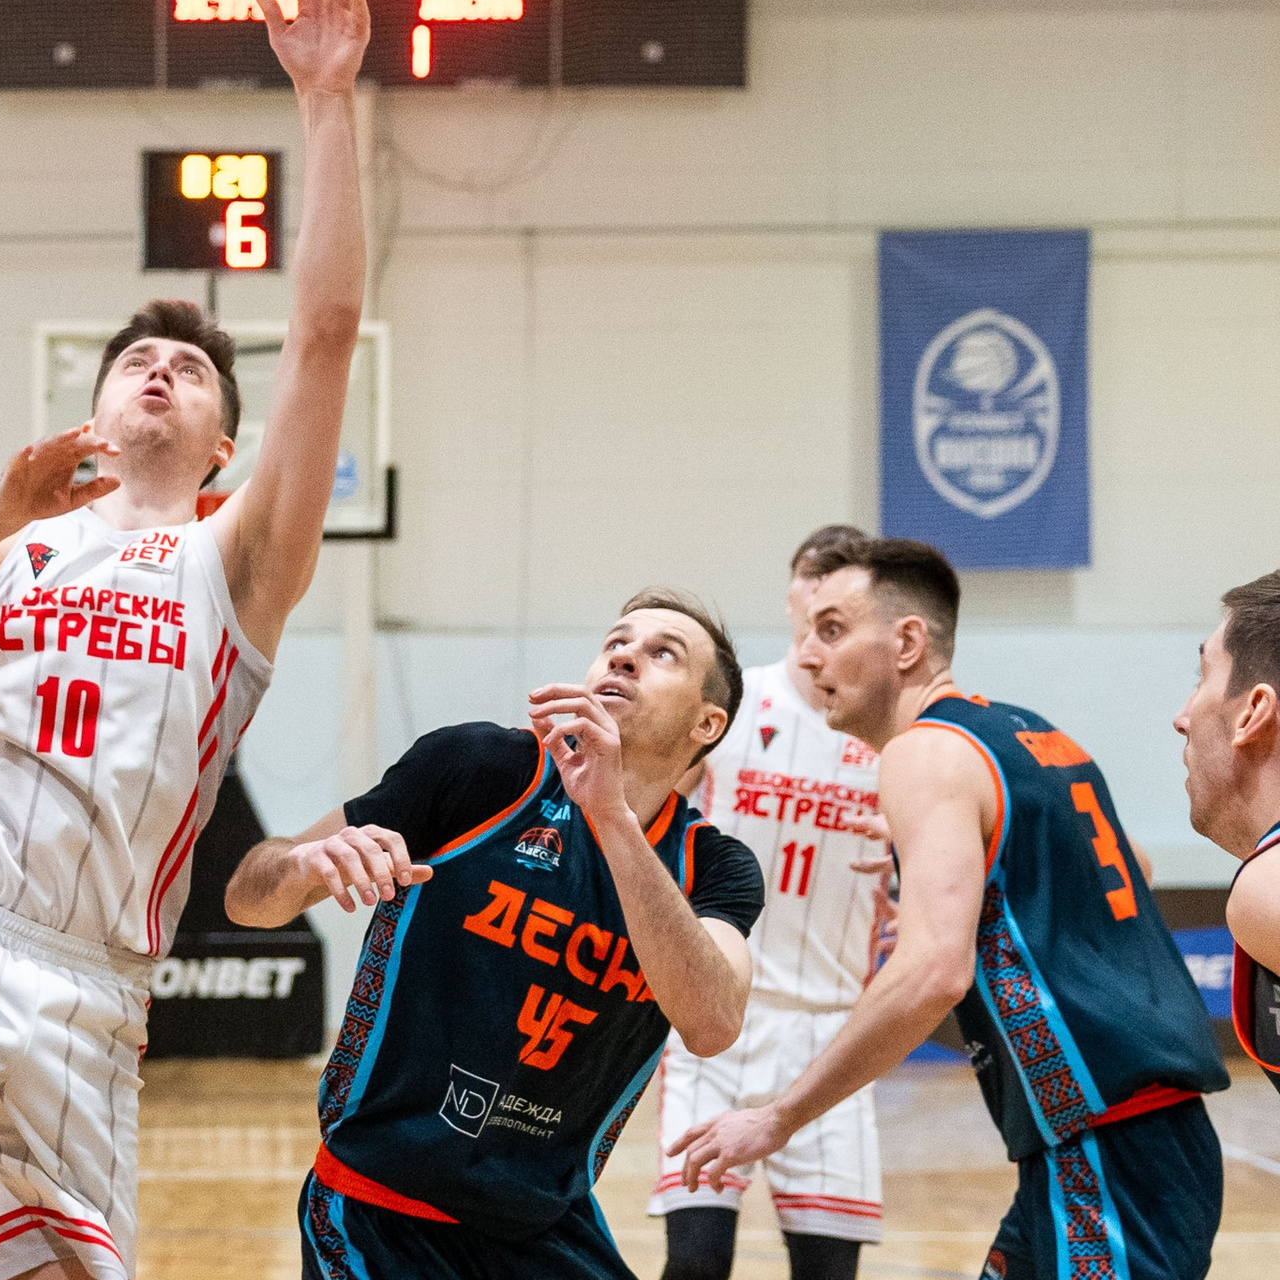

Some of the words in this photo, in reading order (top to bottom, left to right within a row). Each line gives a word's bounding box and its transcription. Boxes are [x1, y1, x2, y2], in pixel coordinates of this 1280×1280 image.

[225, 201, 267, 268] 6
[120, 546, 174, 564] BET
[3, 585, 185, 627] ОКСАРСКИЕ
[36, 676, 101, 758] 10
[779, 840, 816, 898] 11
[1070, 782, 1138, 921] 3
[462, 878, 656, 1004] ДЕСН
[151, 956, 307, 1000] ONBET
[498, 1093, 563, 1124] АДЕЖДА
